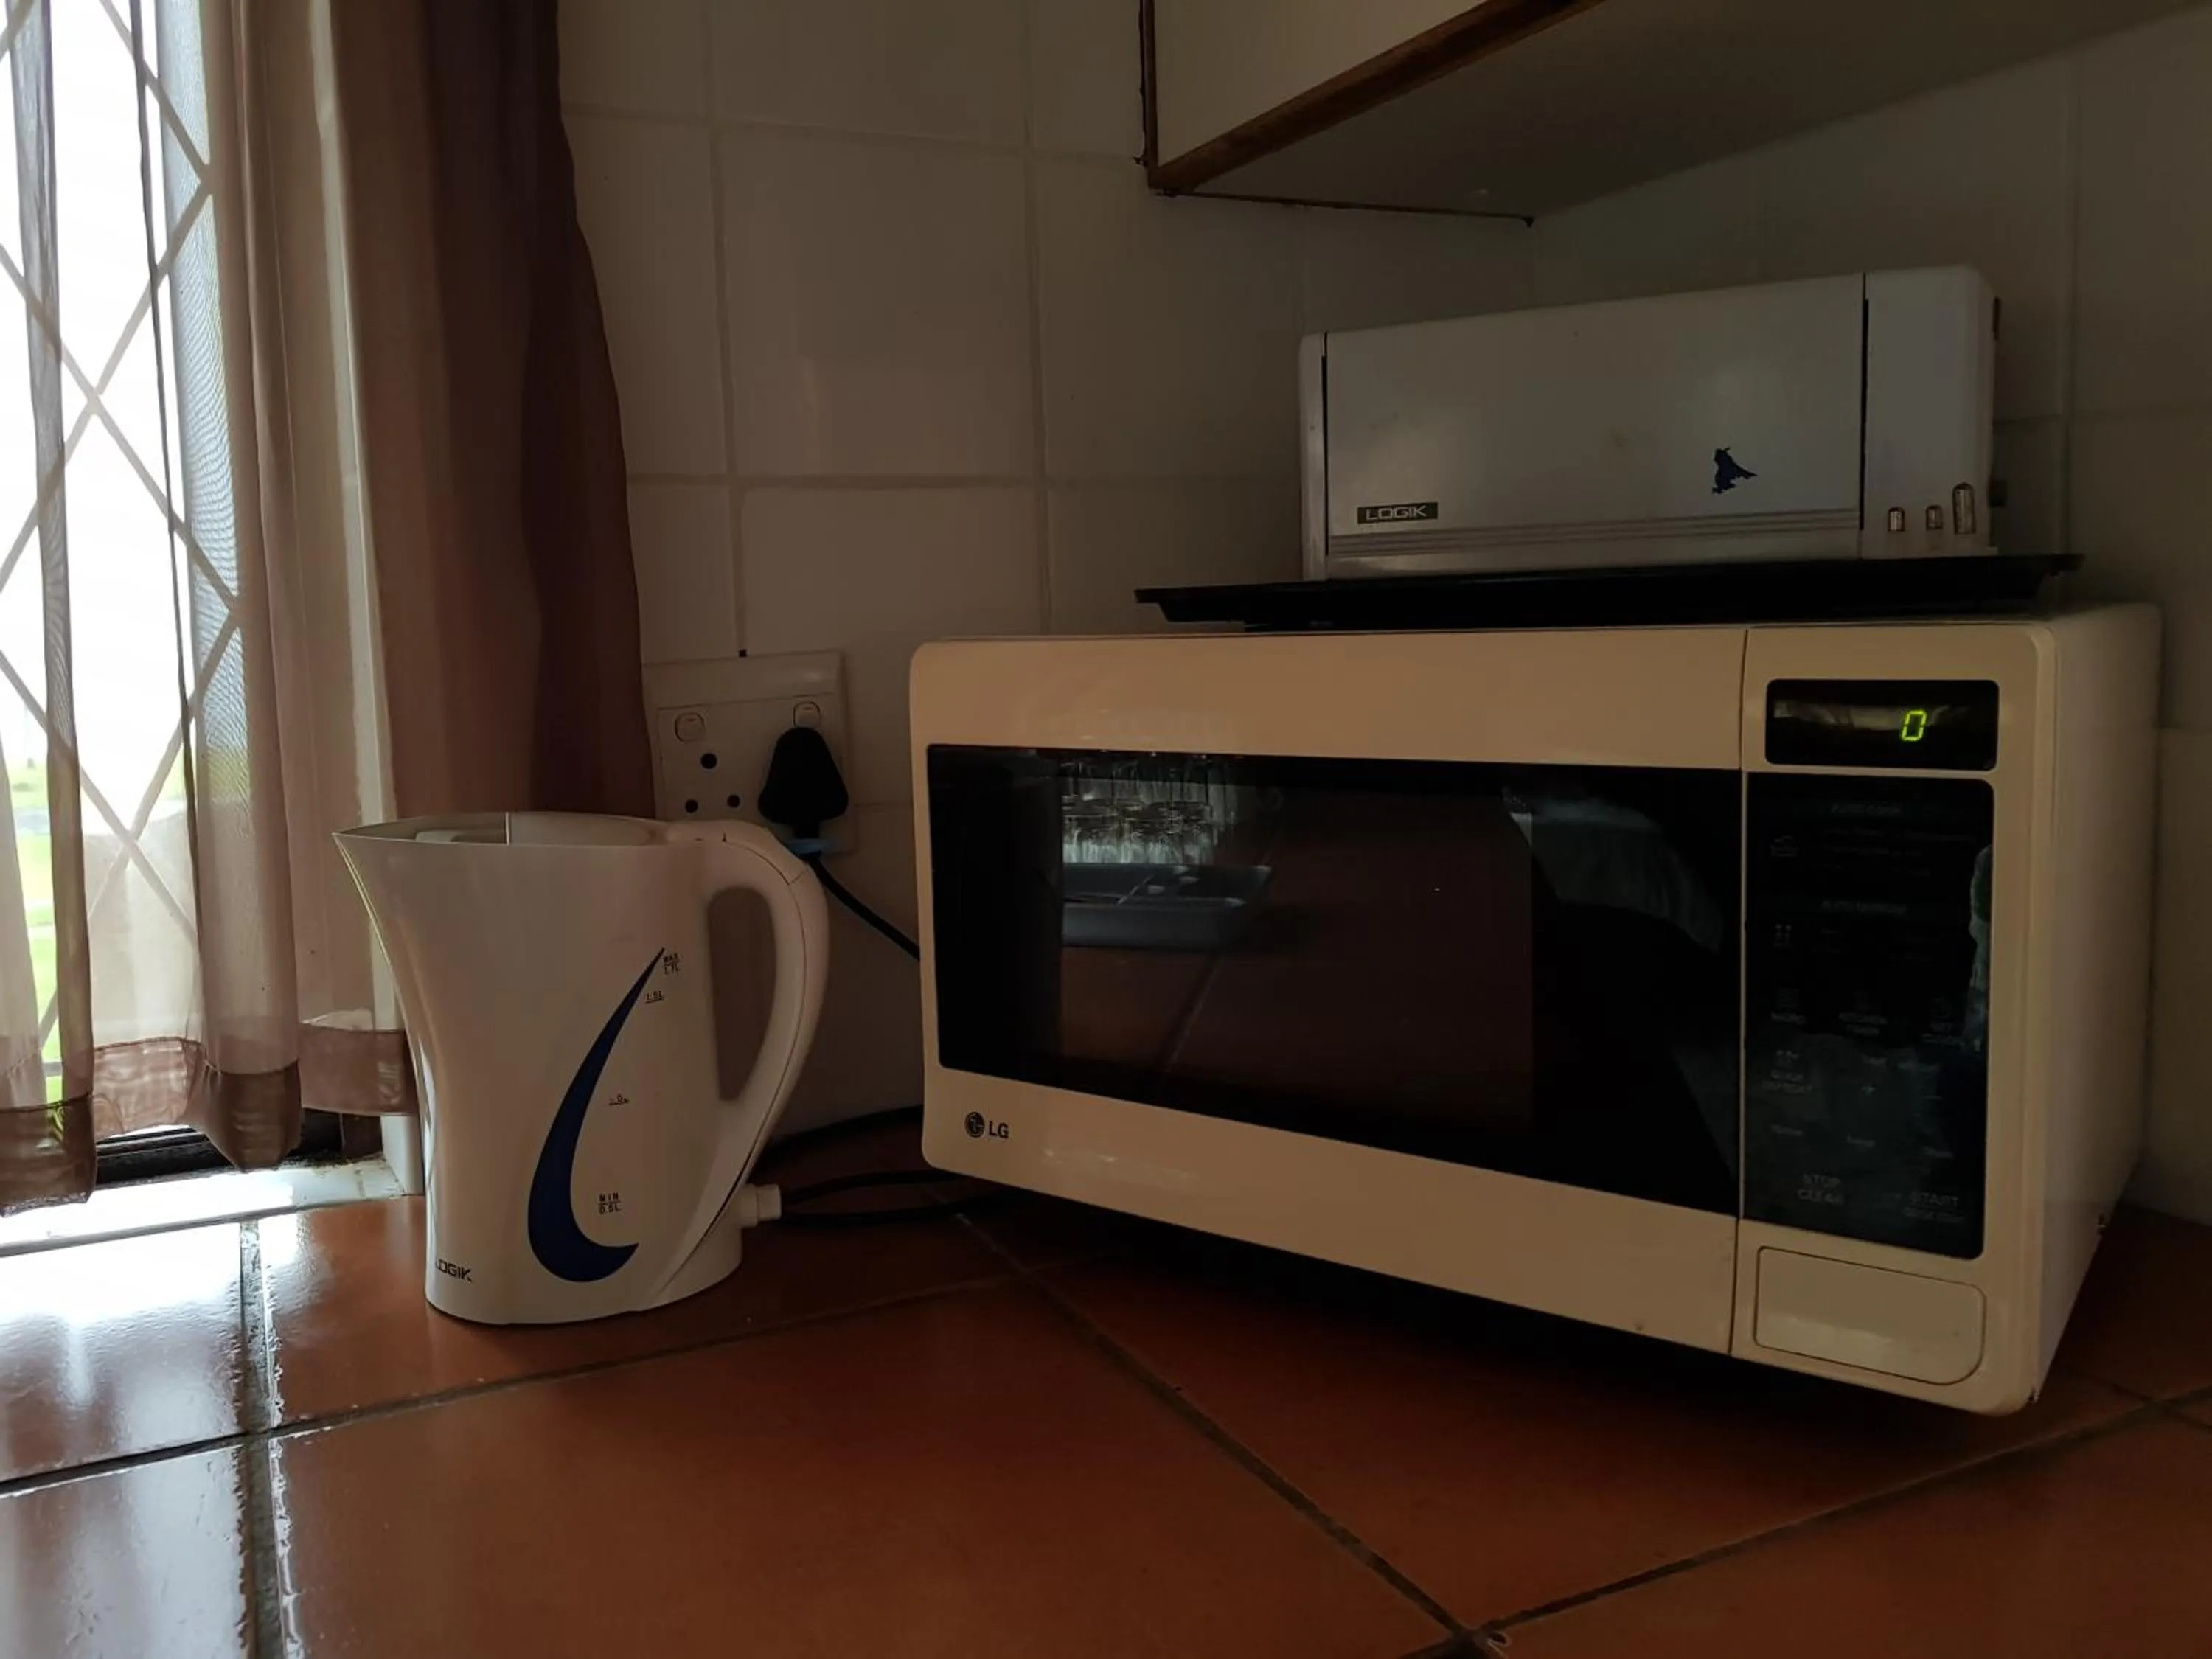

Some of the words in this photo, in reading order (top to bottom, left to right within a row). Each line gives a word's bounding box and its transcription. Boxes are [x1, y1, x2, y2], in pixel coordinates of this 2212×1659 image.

[1366, 504, 1428, 521] LOGIK
[1900, 708, 1928, 742] 0
[989, 1120, 1008, 1139] LG
